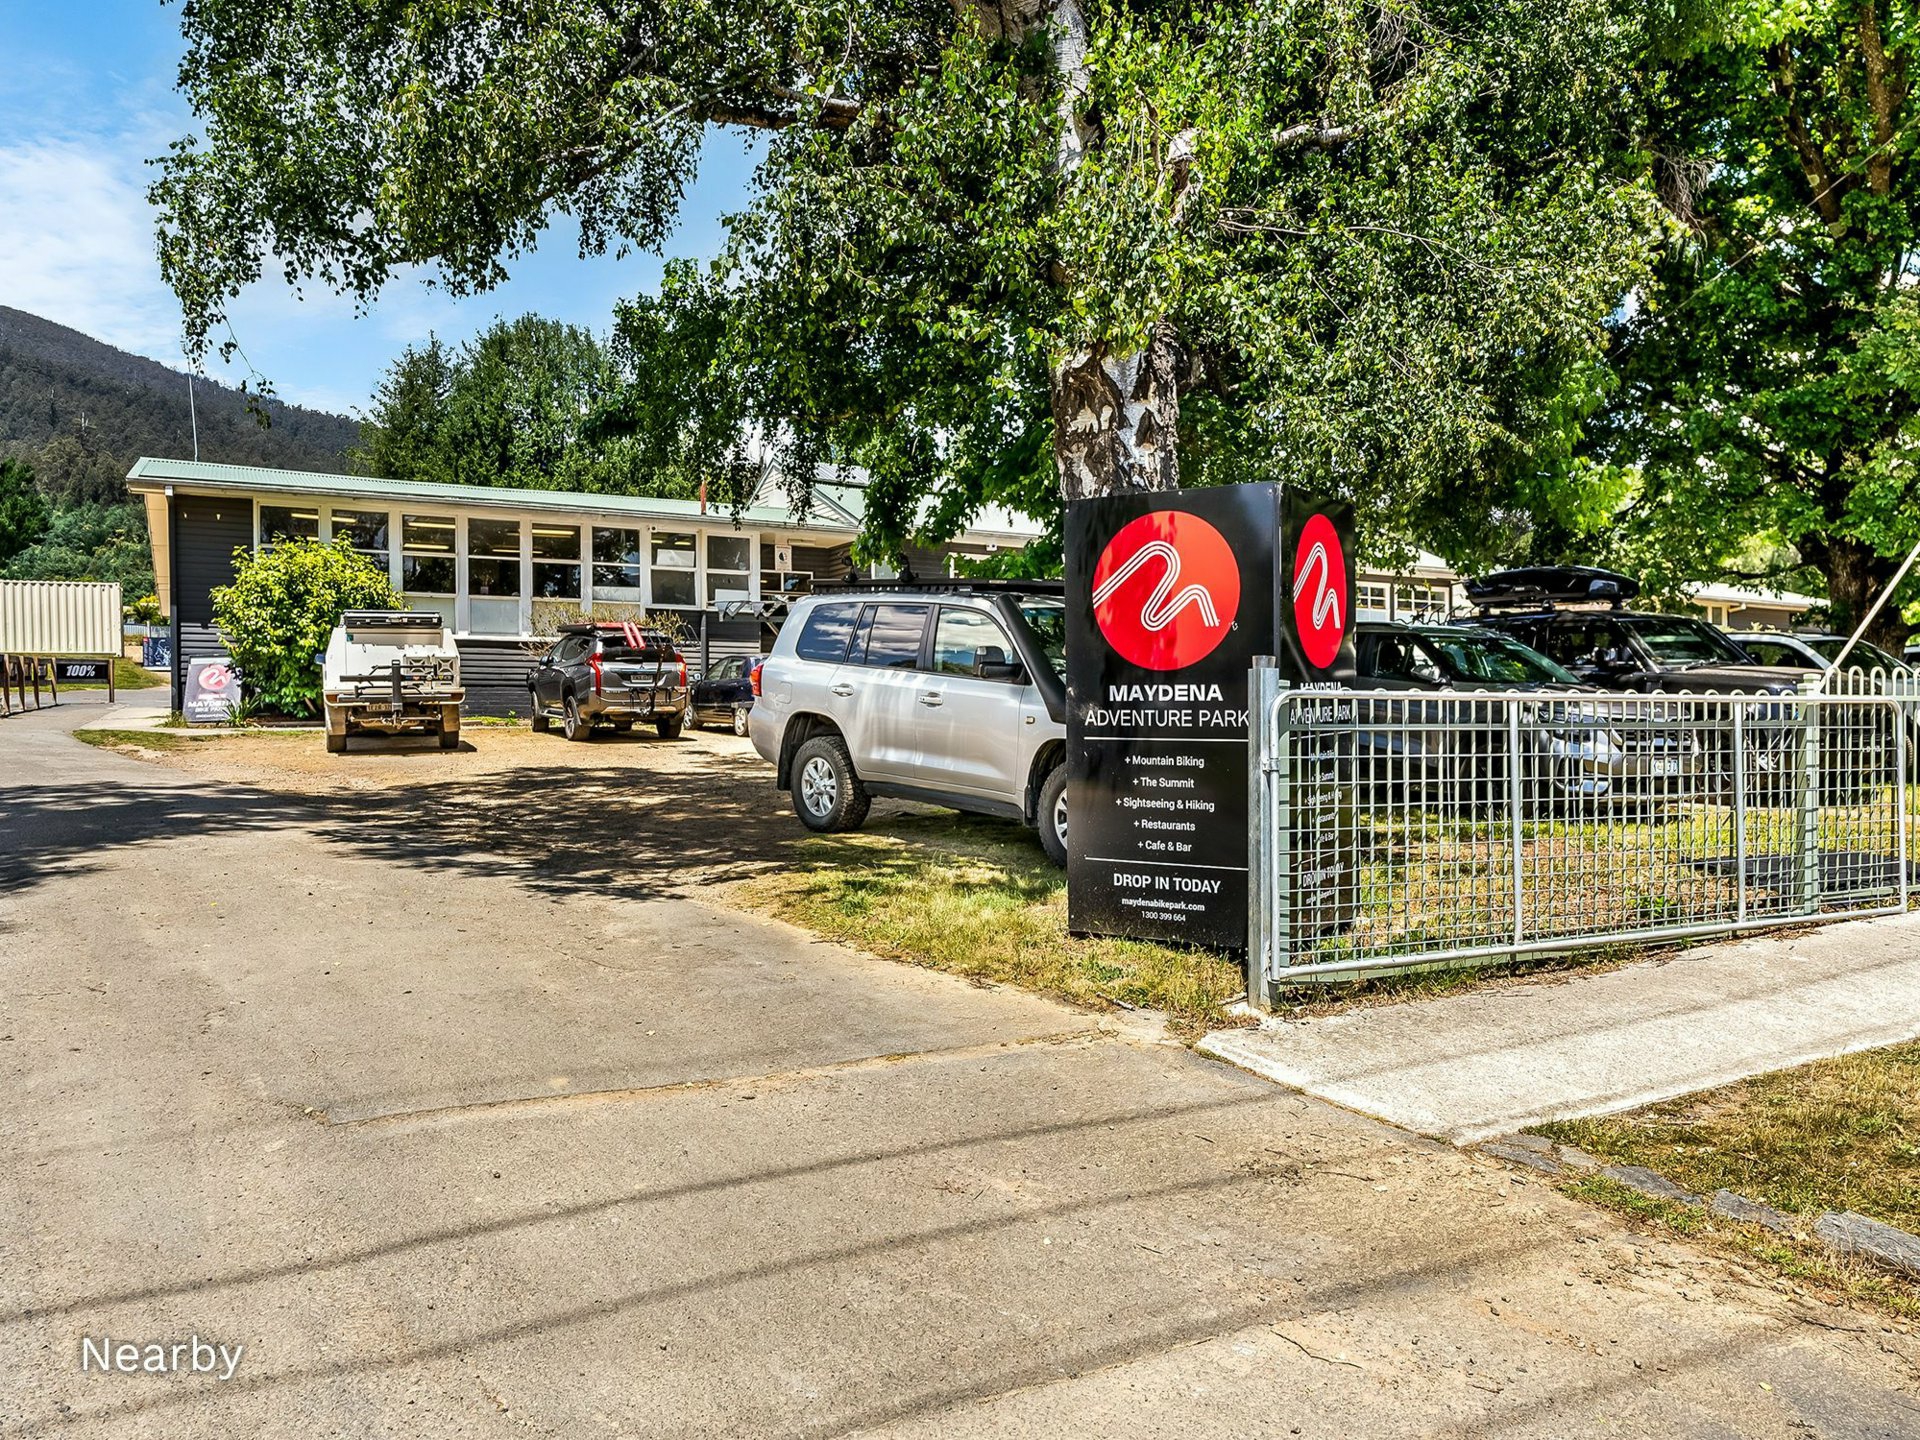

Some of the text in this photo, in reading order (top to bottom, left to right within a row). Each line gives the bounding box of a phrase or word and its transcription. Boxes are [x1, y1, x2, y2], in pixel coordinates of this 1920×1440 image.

[66, 665, 96, 677] 100%
[1109, 684, 1224, 702] MAYDENA
[1084, 709, 1249, 727] ADVENTURE PARK
[1132, 755, 1175, 766] Mountain
[1176, 756, 1205, 769] Biking
[1140, 777, 1157, 787] The
[1159, 778, 1195, 788] Summit
[1123, 797, 1175, 811] Sightseeing
[1176, 799, 1184, 809] &
[1185, 800, 1215, 812] Hiking
[1141, 819, 1196, 831] Restaurants
[1145, 840, 1165, 851] Cafe
[1167, 841, 1174, 851] &
[1176, 842, 1192, 852] Bar
[1113, 873, 1221, 893] DROP IN TODAY
[1122, 898, 1205, 911] maydenabikepark.com
[1141, 911, 1186, 922] 1300 399 664
